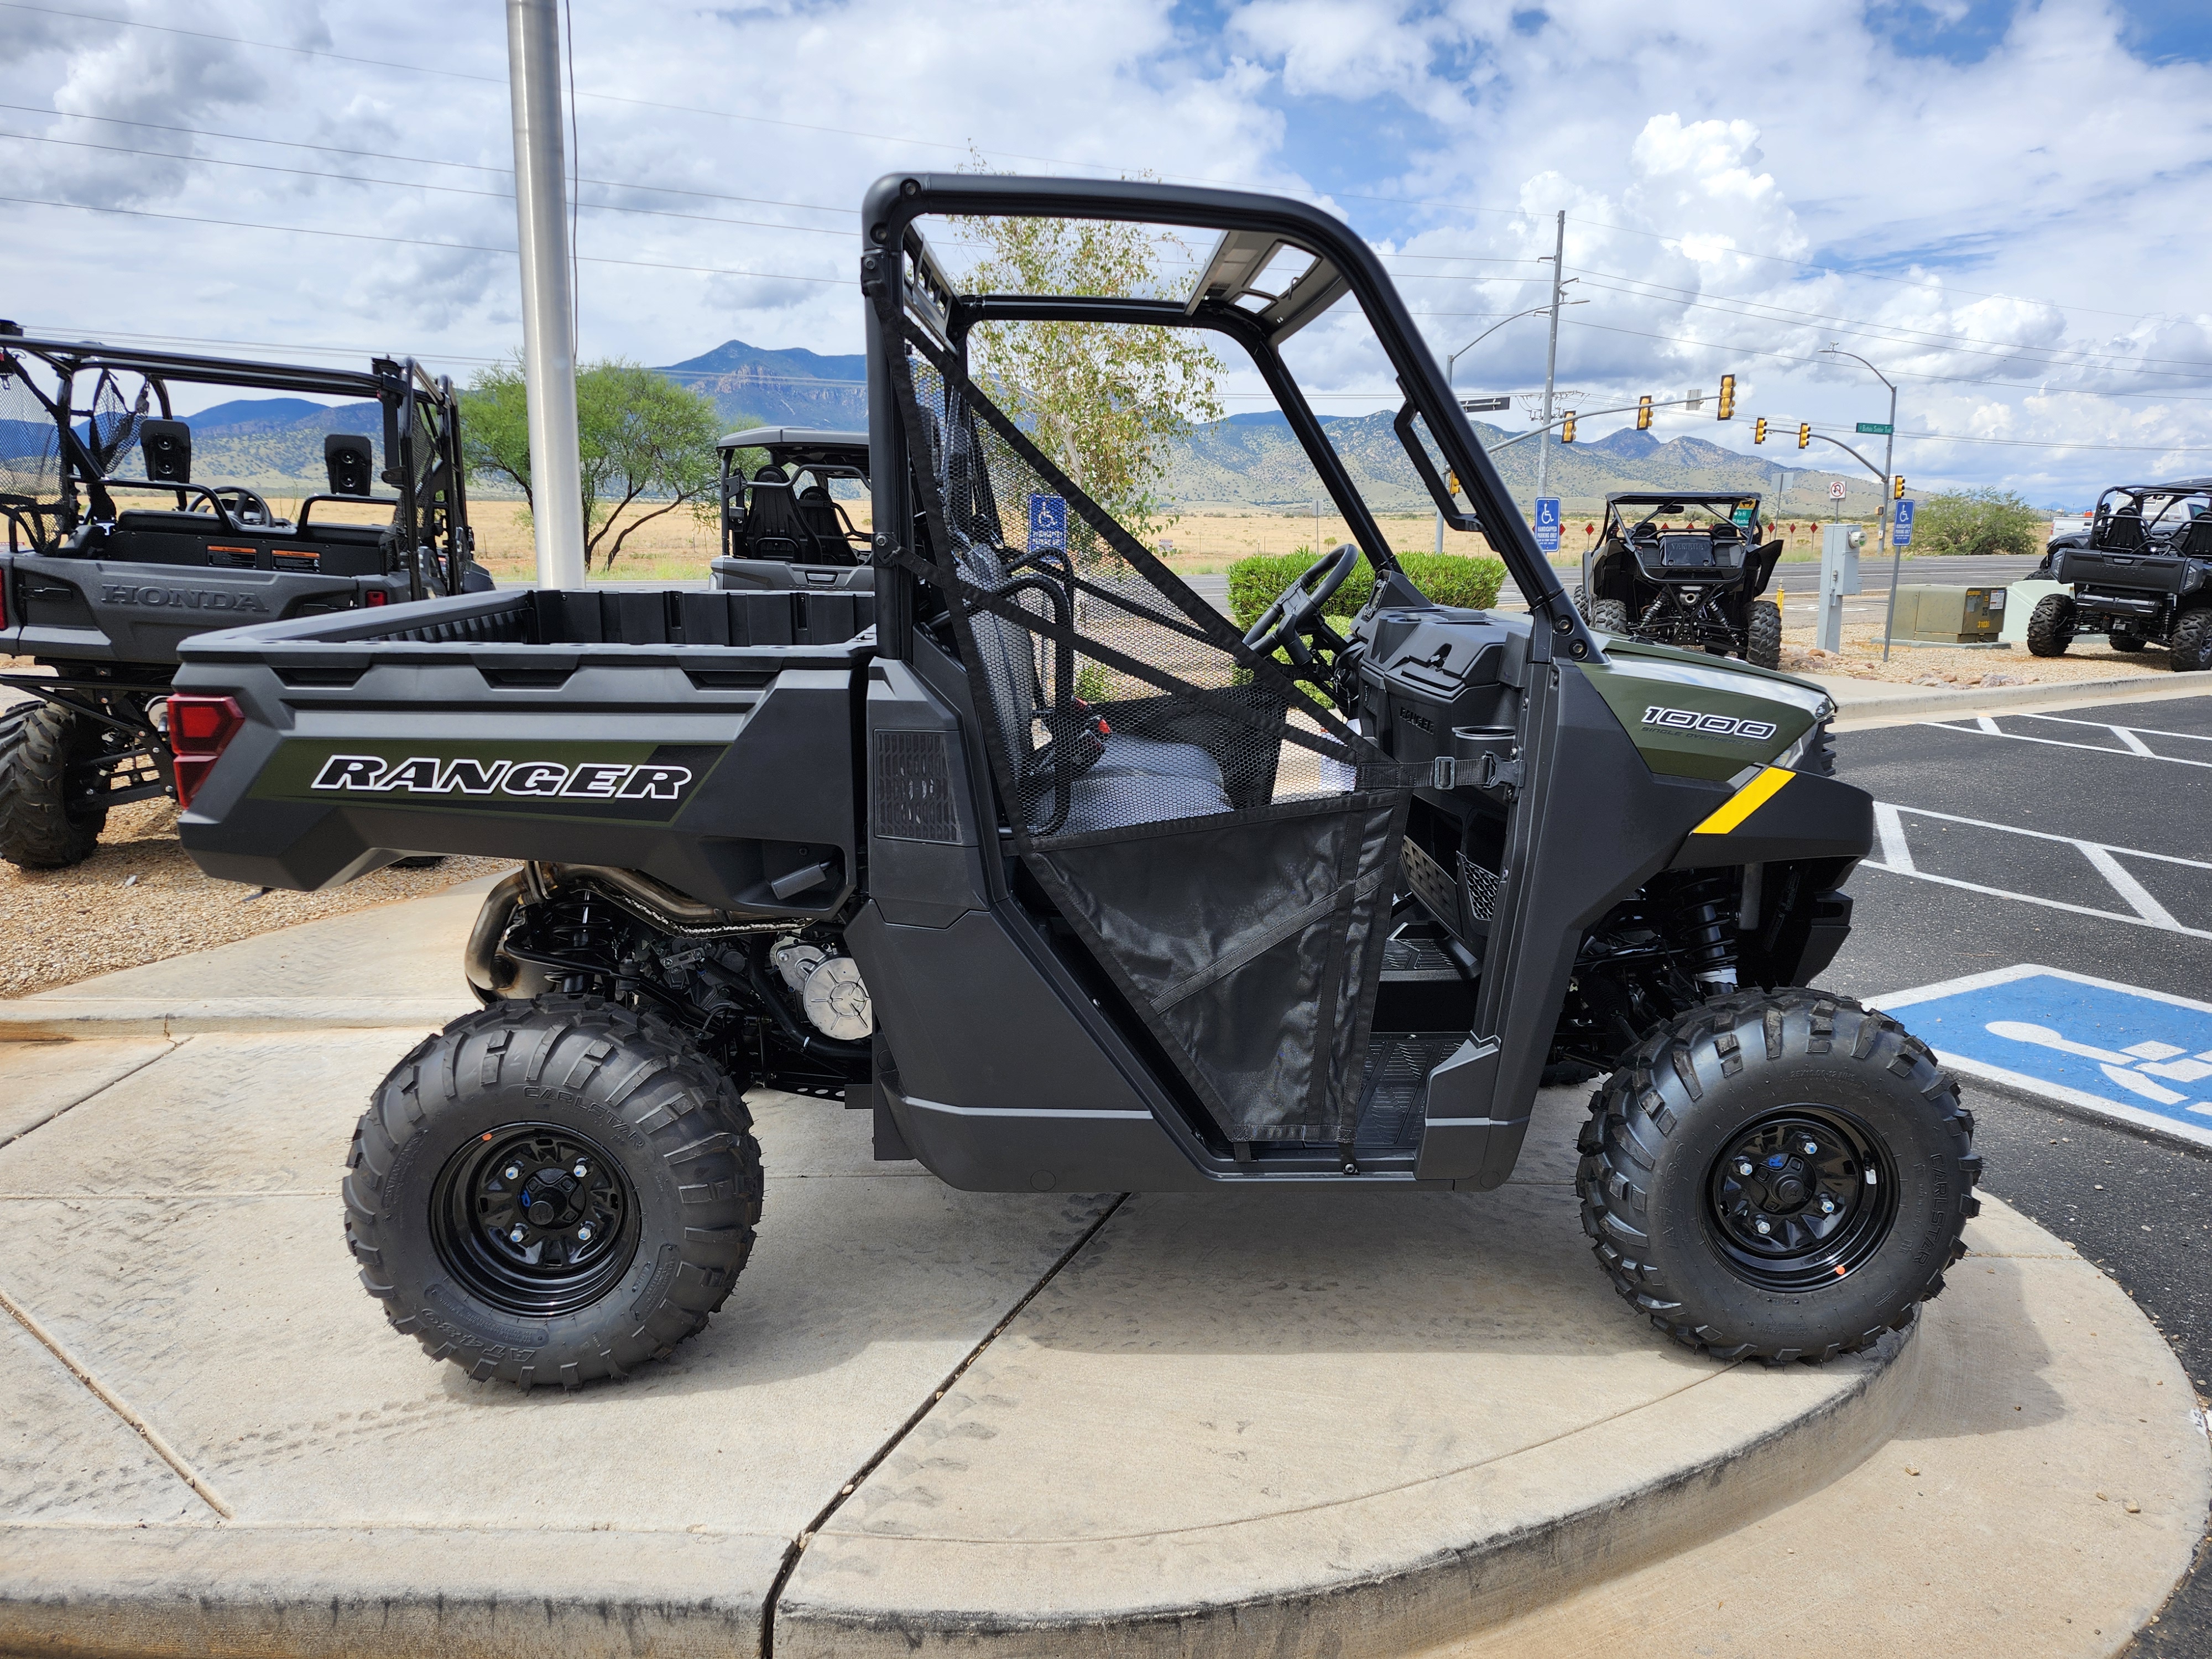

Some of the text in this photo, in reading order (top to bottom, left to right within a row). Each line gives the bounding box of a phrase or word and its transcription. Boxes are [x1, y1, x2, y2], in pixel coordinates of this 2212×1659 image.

[101, 584, 269, 613] HONDA
[1400, 707, 1434, 735] RANGER
[1641, 706, 1777, 740] 1000
[1641, 726, 1683, 737] SINGLE
[1686, 733, 1744, 745] OVERHEAD
[311, 754, 692, 800] RANGER
[523, 1086, 645, 1149] CARLSTAR
[1912, 1152, 1947, 1267] CARLSTAR
